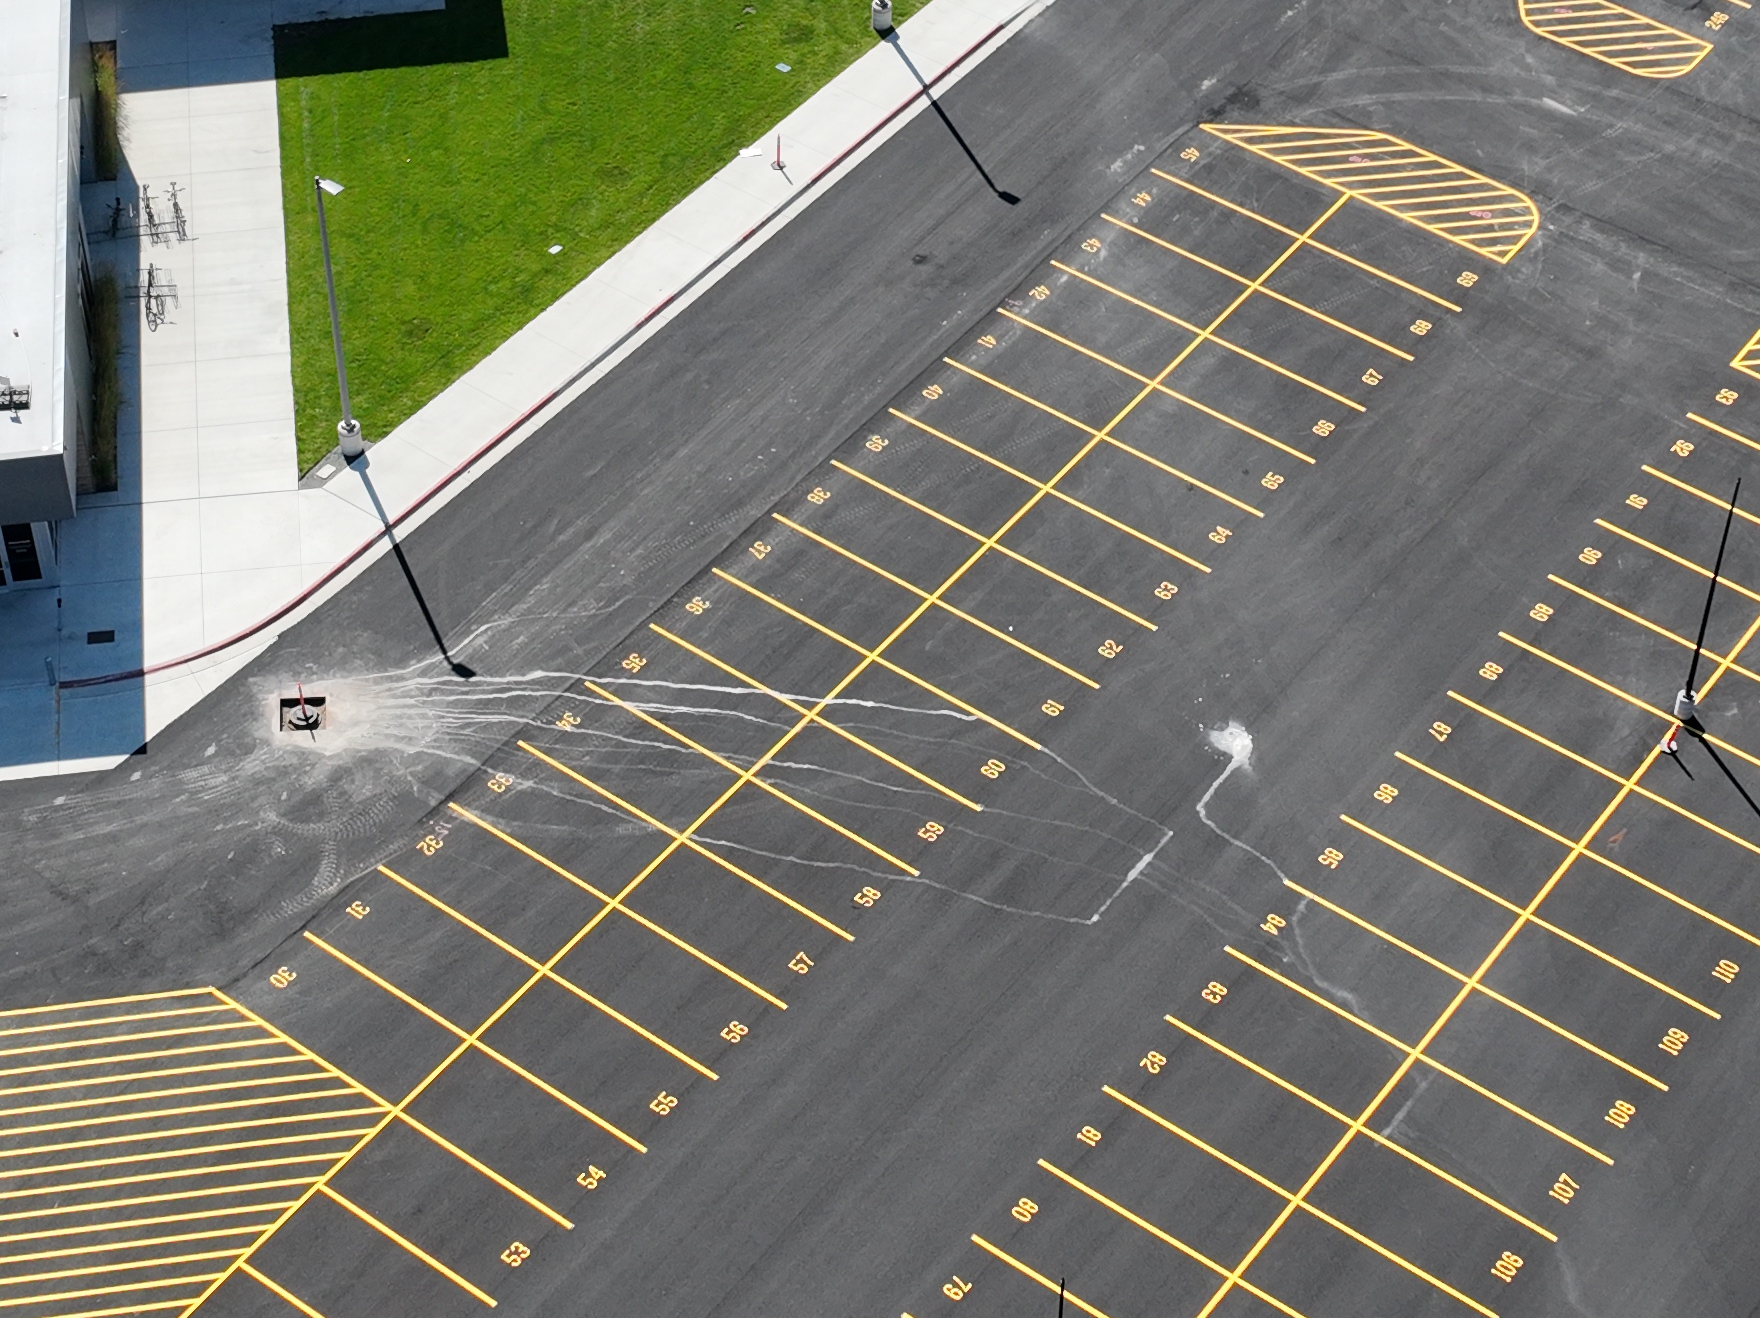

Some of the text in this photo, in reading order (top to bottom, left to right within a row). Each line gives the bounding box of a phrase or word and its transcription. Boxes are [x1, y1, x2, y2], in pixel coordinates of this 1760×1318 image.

[1180, 147, 1199, 161] 45
[1457, 271, 1479, 287] 69
[1029, 285, 1050, 299] 42
[1362, 368, 1381, 385] 67
[923, 385, 942, 399] 40
[1715, 389, 1738, 405] 93
[1261, 473, 1284, 490] 65
[807, 487, 831, 504] 38
[1626, 495, 1648, 509] 91
[1154, 582, 1178, 599] 63
[1529, 603, 1554, 621] 89
[622, 653, 647, 673] 35
[1042, 700, 1064, 716] 61
[1430, 722, 1451, 742] 87
[917, 822, 944, 841] 59
[416, 835, 443, 856] 32
[1318, 848, 1344, 869] 85
[269, 967, 296, 989] 30
[1202, 982, 1227, 1003] 83
[720, 1022, 748, 1043] 56
[1659, 1028, 1689, 1056] 109
[577, 1165, 606, 1189] 54
[1549, 1173, 1580, 1204] 107
[1012, 1198, 1038, 1222] 80
